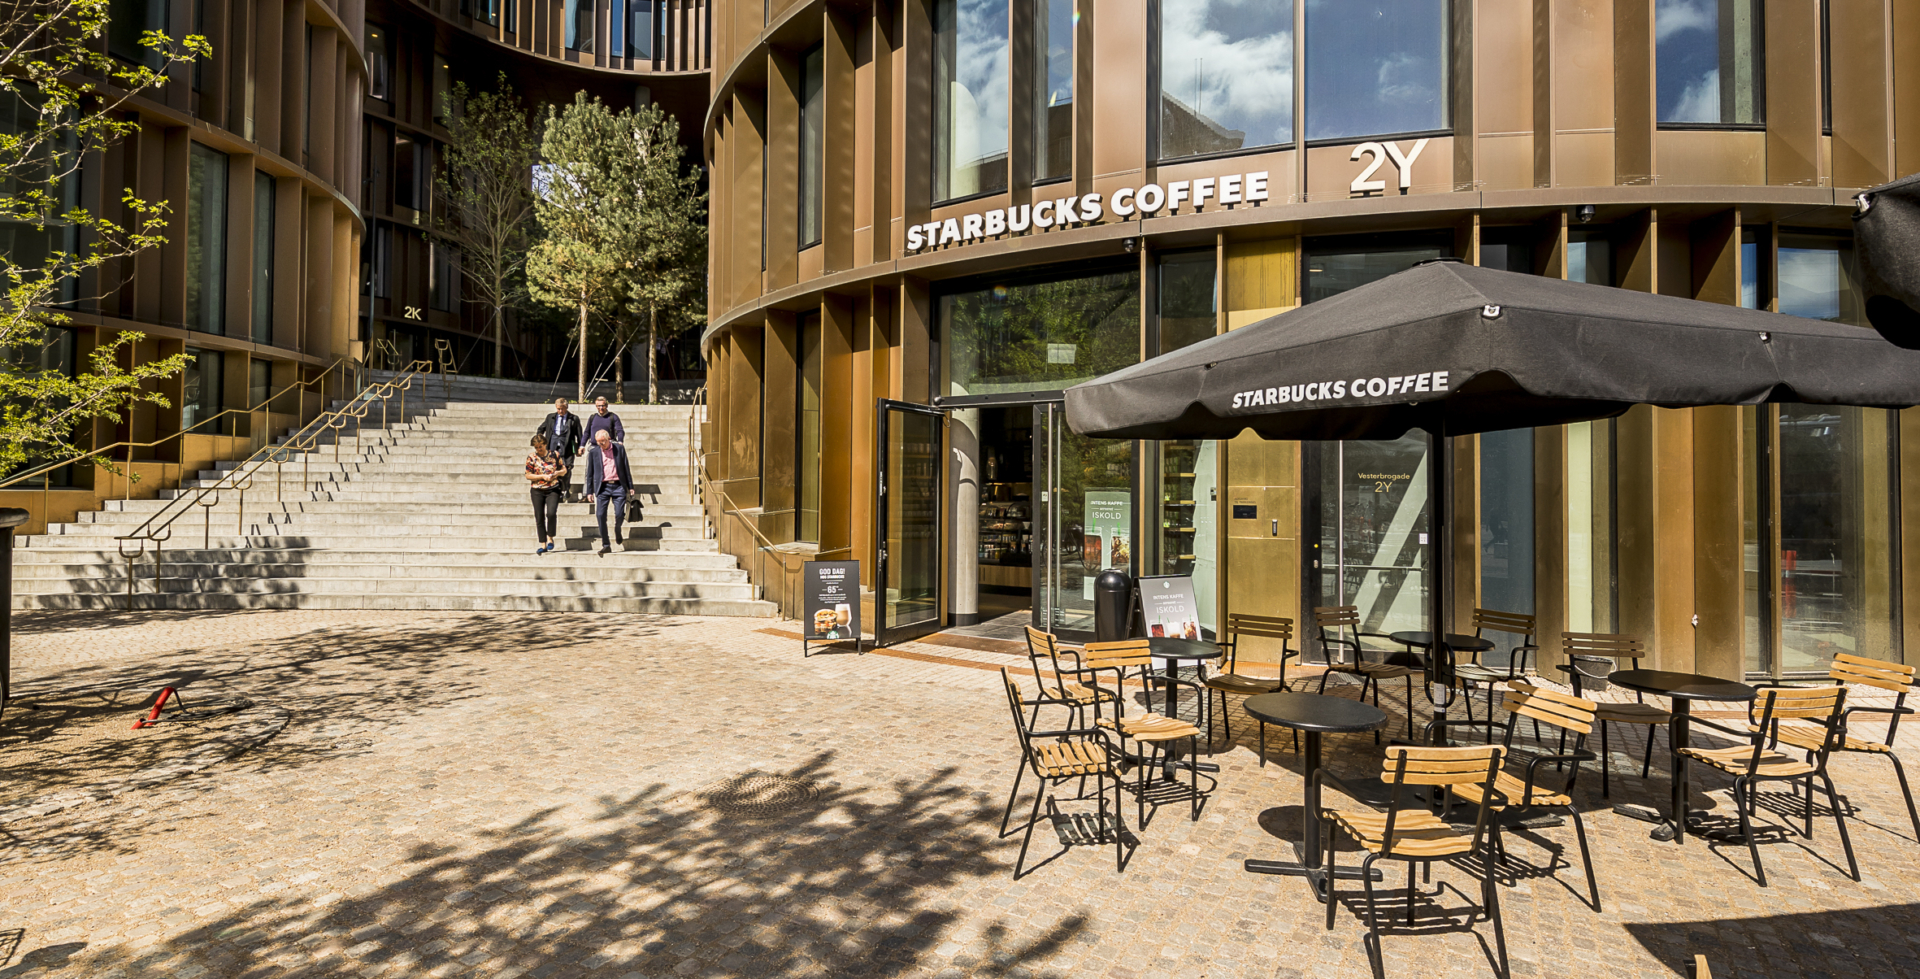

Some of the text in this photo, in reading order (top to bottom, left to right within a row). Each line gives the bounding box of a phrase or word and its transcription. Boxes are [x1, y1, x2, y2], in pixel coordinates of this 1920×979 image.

[1350, 138, 1430, 192] 2Y
[907, 171, 1269, 250] STARBUCKS COFFEE
[404, 305, 422, 321] 2K
[1232, 371, 1449, 409] STARBUCKS COFFEE
[1358, 472, 1410, 481] Vesterbrogade
[1374, 481, 1393, 493] 2Y
[1092, 511, 1122, 520] ISKOLD
[1156, 605, 1185, 614] ISKOLD
